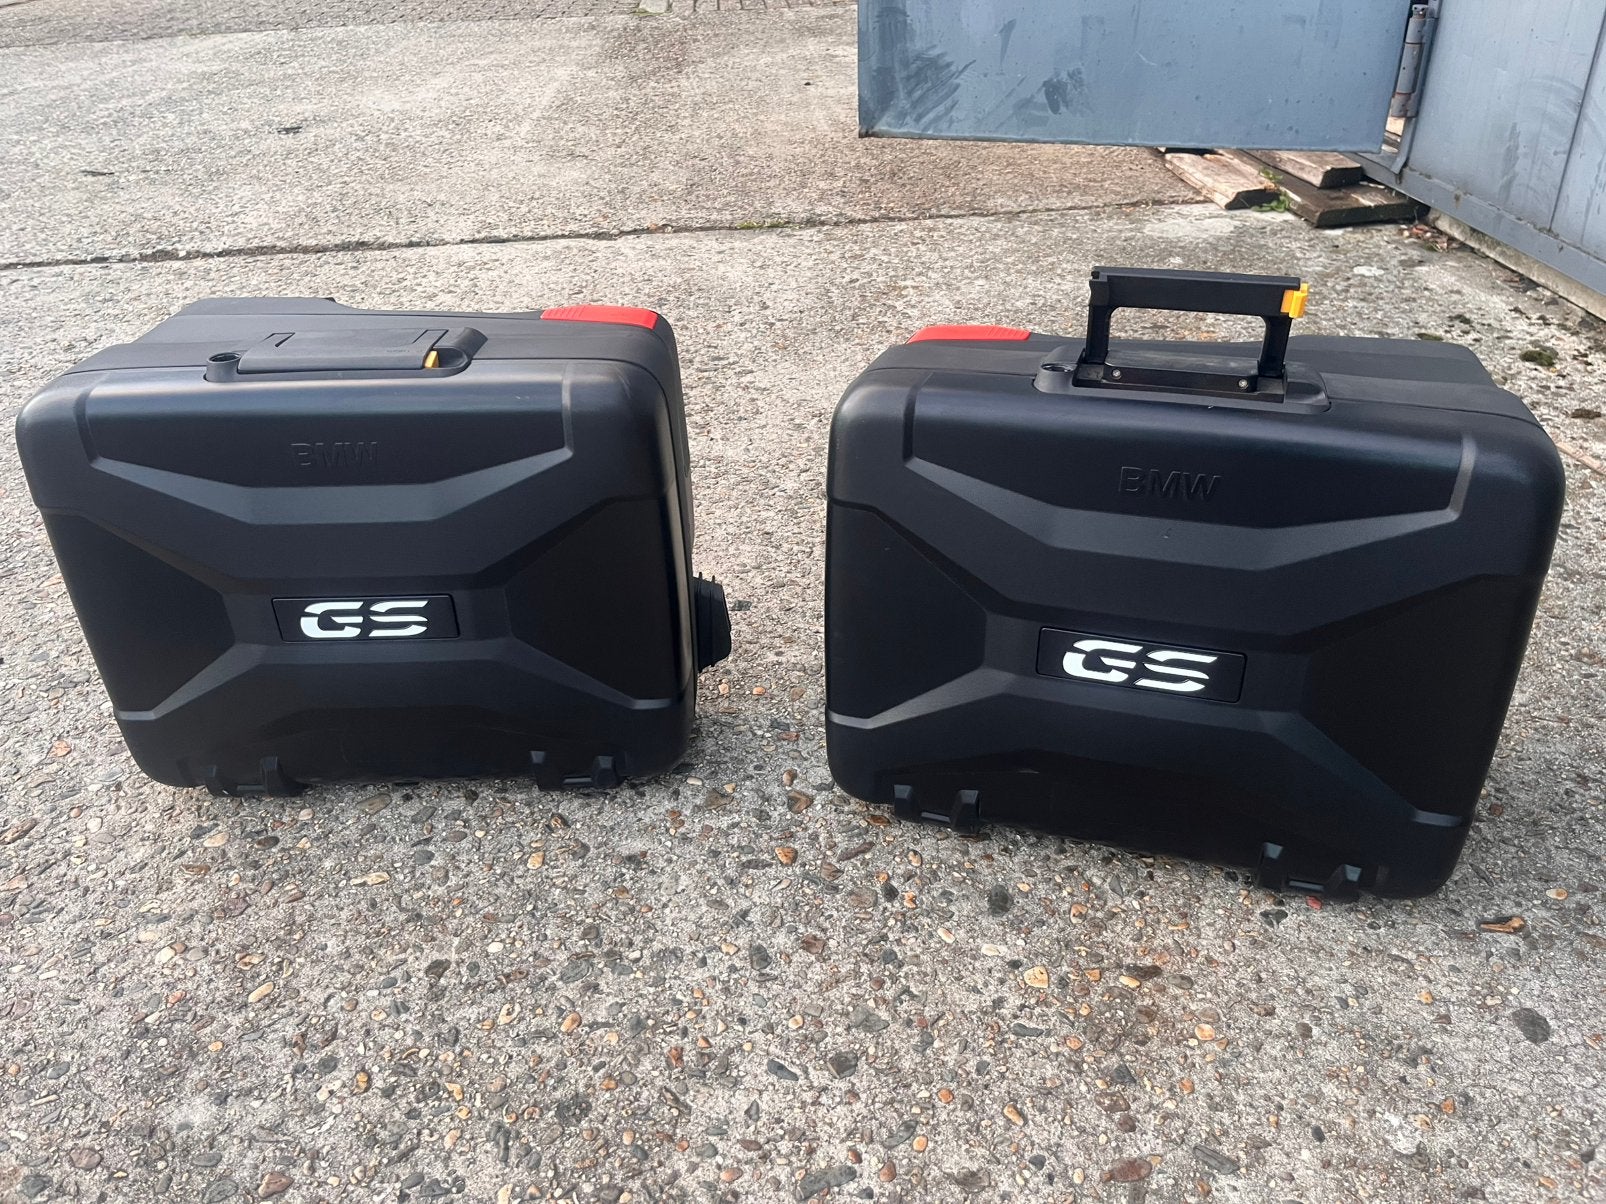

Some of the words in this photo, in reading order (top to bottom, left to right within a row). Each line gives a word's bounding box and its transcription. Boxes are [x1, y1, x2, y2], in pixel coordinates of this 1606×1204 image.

[289, 441, 378, 468] BMW
[1119, 465, 1221, 500] BMW
[300, 600, 429, 639] GS
[1062, 639, 1218, 692] GS
